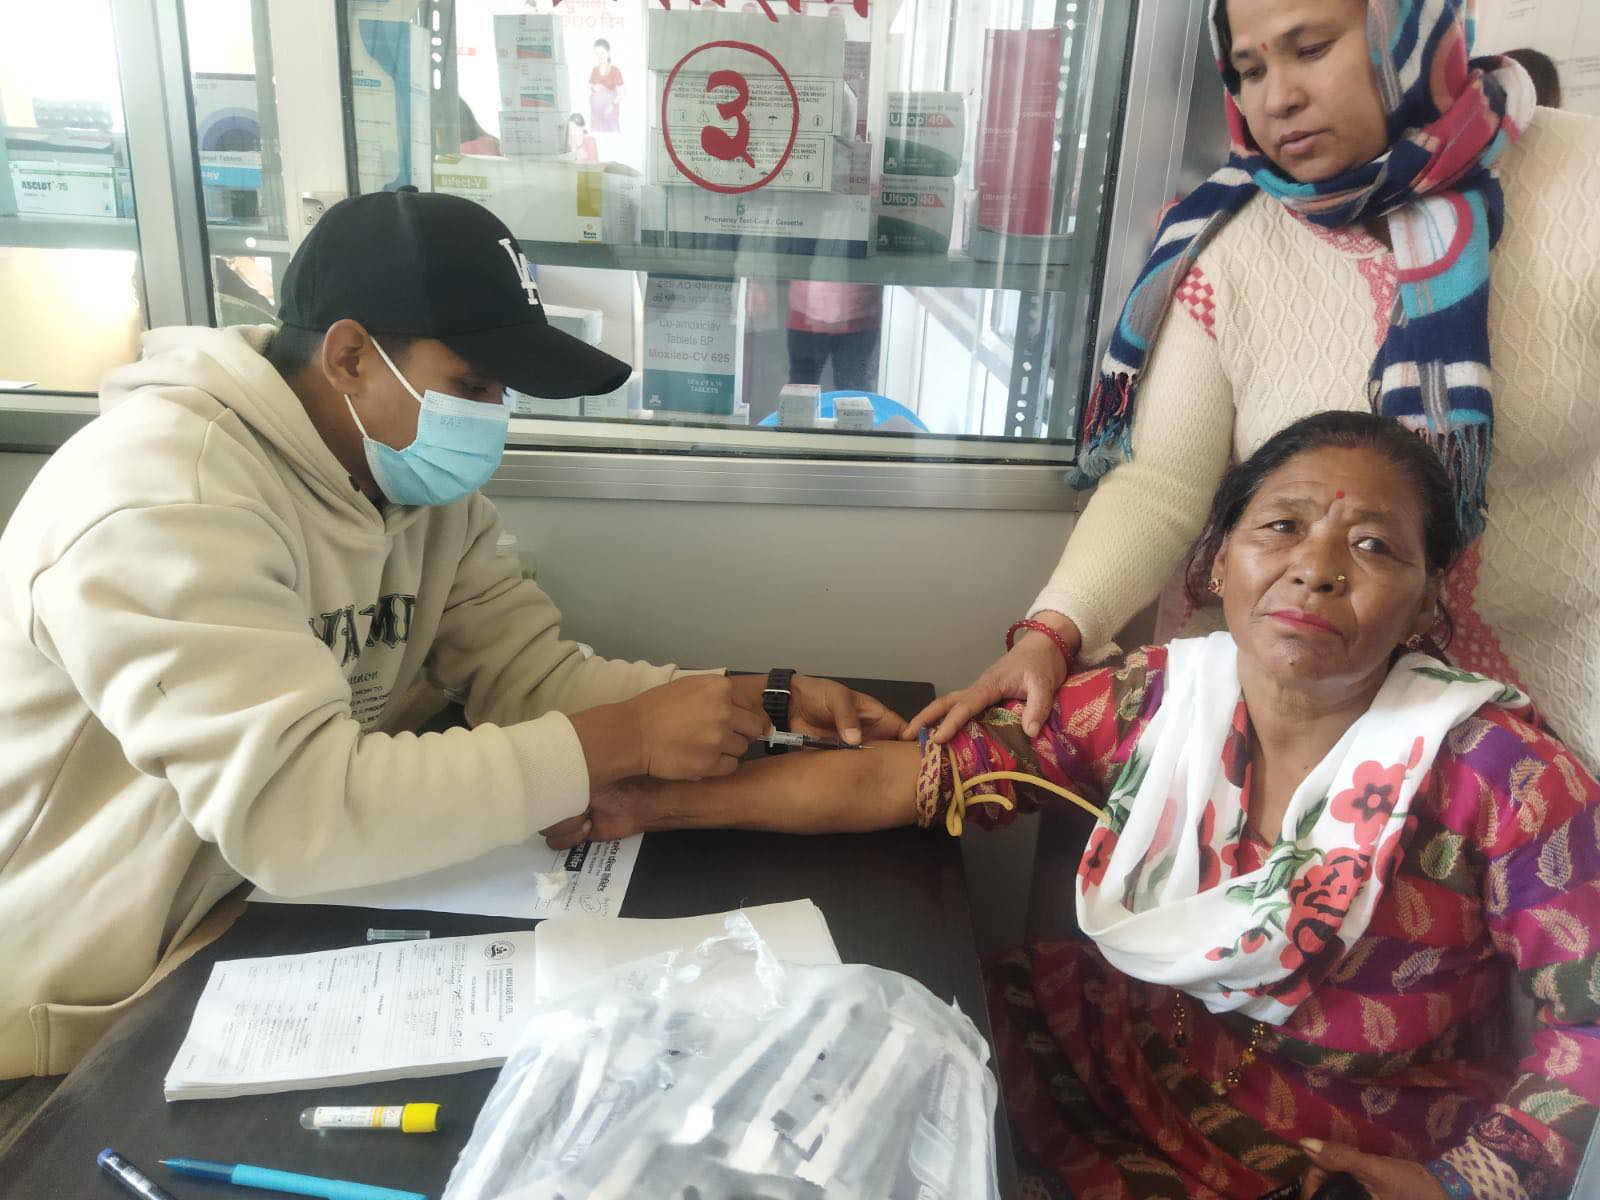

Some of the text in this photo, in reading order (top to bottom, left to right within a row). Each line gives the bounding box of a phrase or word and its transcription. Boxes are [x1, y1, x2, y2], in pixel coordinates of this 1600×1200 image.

[890, 113, 944, 127] Uop 40
[882, 193, 935, 207] Ultop 40
[664, 333, 714, 347] Tablets BP
[710, 352, 731, 364] 625
